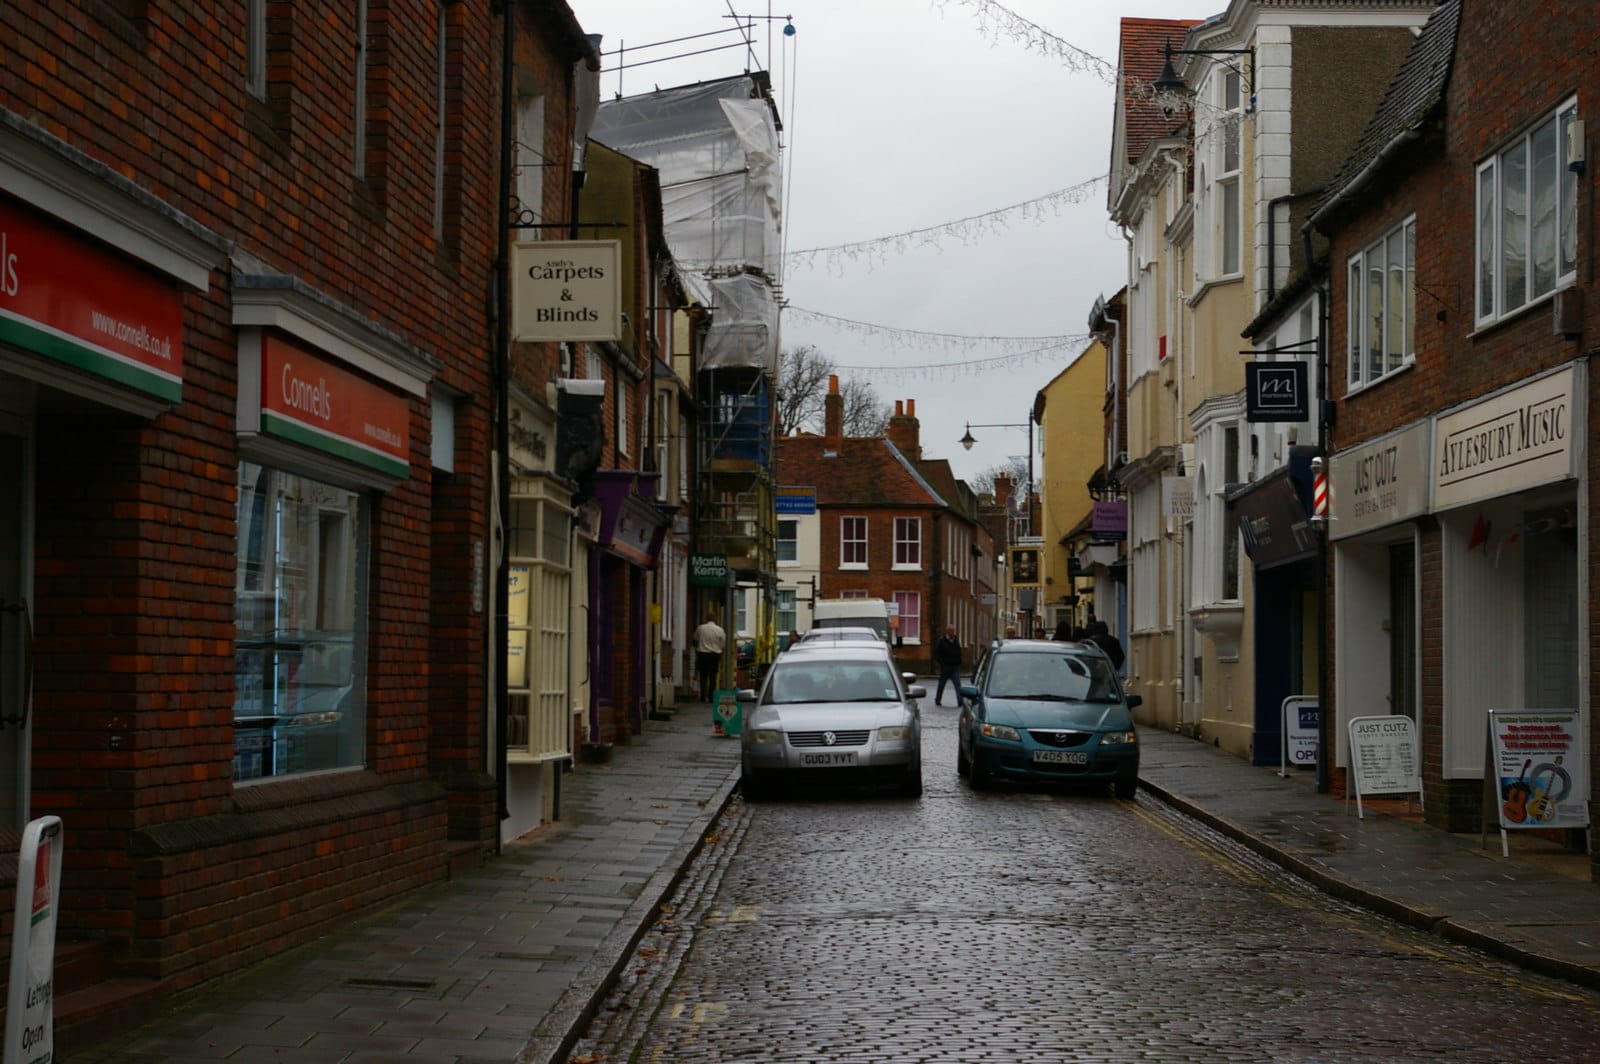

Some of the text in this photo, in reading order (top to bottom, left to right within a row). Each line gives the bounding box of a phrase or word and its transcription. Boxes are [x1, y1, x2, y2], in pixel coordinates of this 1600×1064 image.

[529, 265, 604, 283] Carpets
[560, 288, 575, 302] &
[536, 307, 599, 322] Blinds
[91, 310, 172, 361] www.connells.co.uk
[281, 362, 332, 421] Connells
[1440, 403, 1566, 477] AYLESBURY MUSIC
[1354, 445, 1398, 495] JUST CUTZ
[692, 556, 727, 567] Martin
[694, 567, 727, 577] Kemp
[1357, 722, 1409, 734] JUST CUTZ
[22, 1024, 44, 1054] Open
